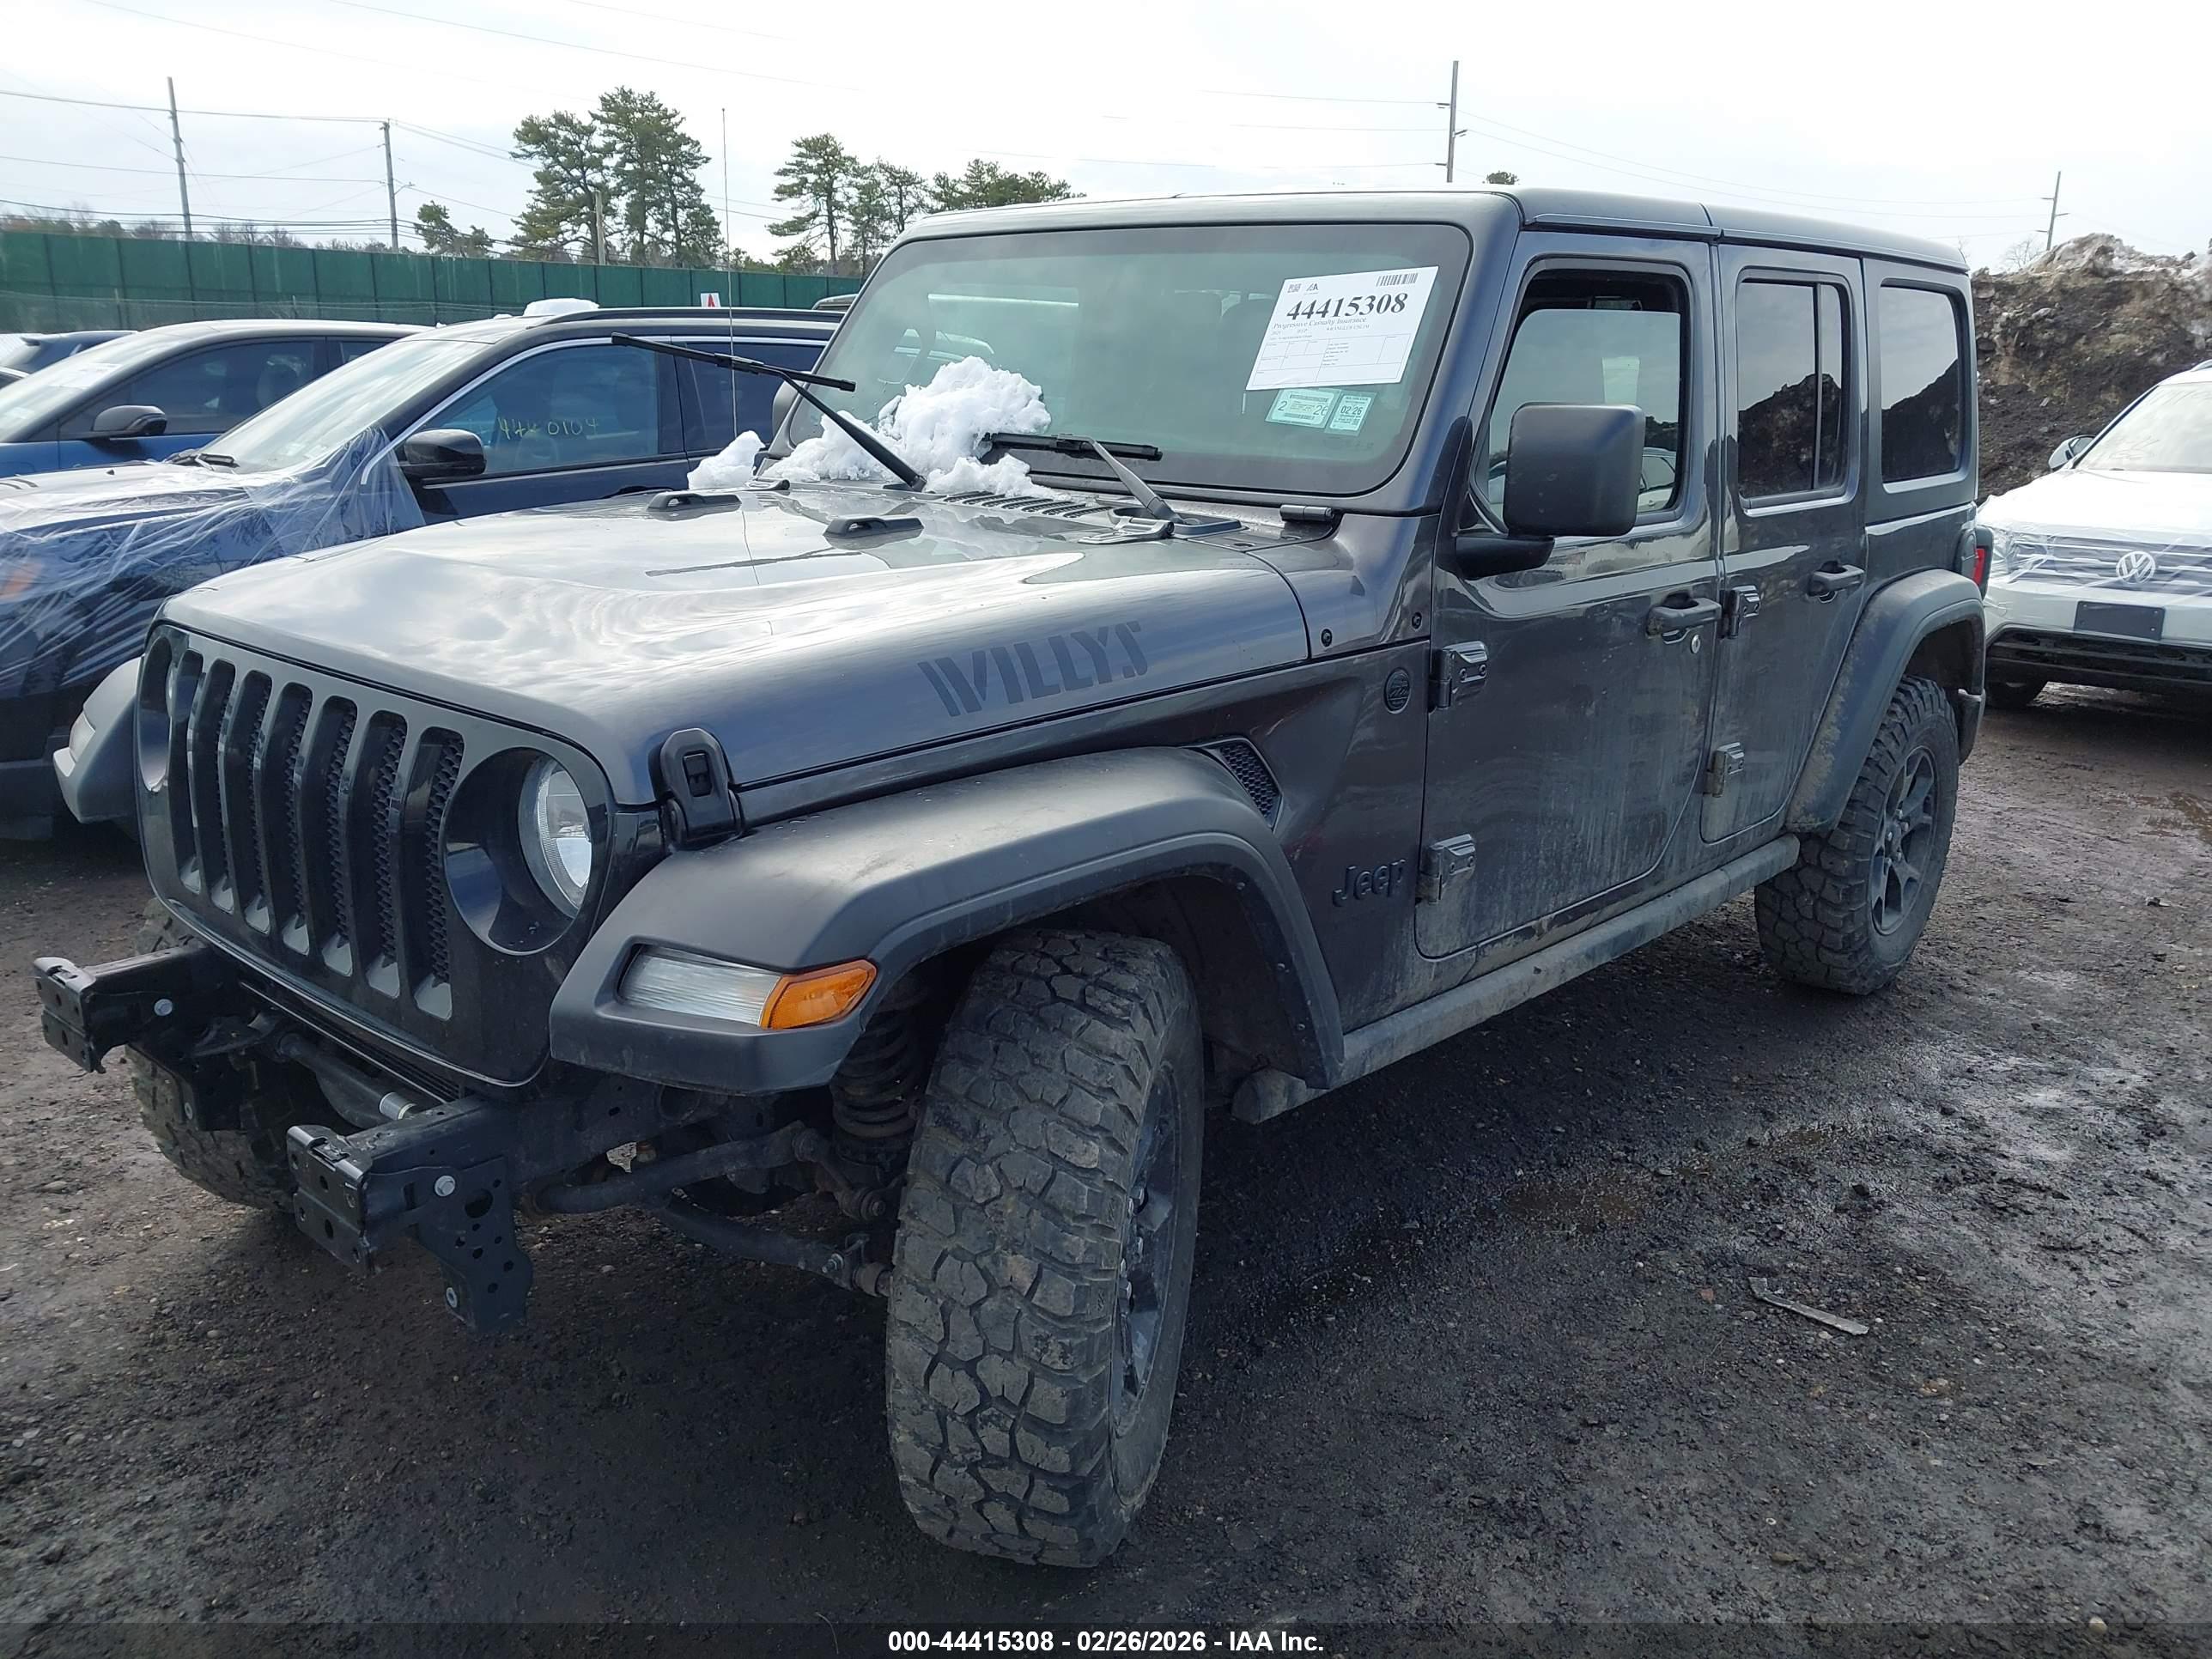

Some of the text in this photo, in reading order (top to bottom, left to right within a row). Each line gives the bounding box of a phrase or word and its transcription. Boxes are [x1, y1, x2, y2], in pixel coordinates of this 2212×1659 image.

[1286, 293, 1408, 320] 44415308
[1277, 400, 1288, 411] 2
[917, 621, 1148, 717] WILLYS
[1333, 859, 1407, 907] Jeep
